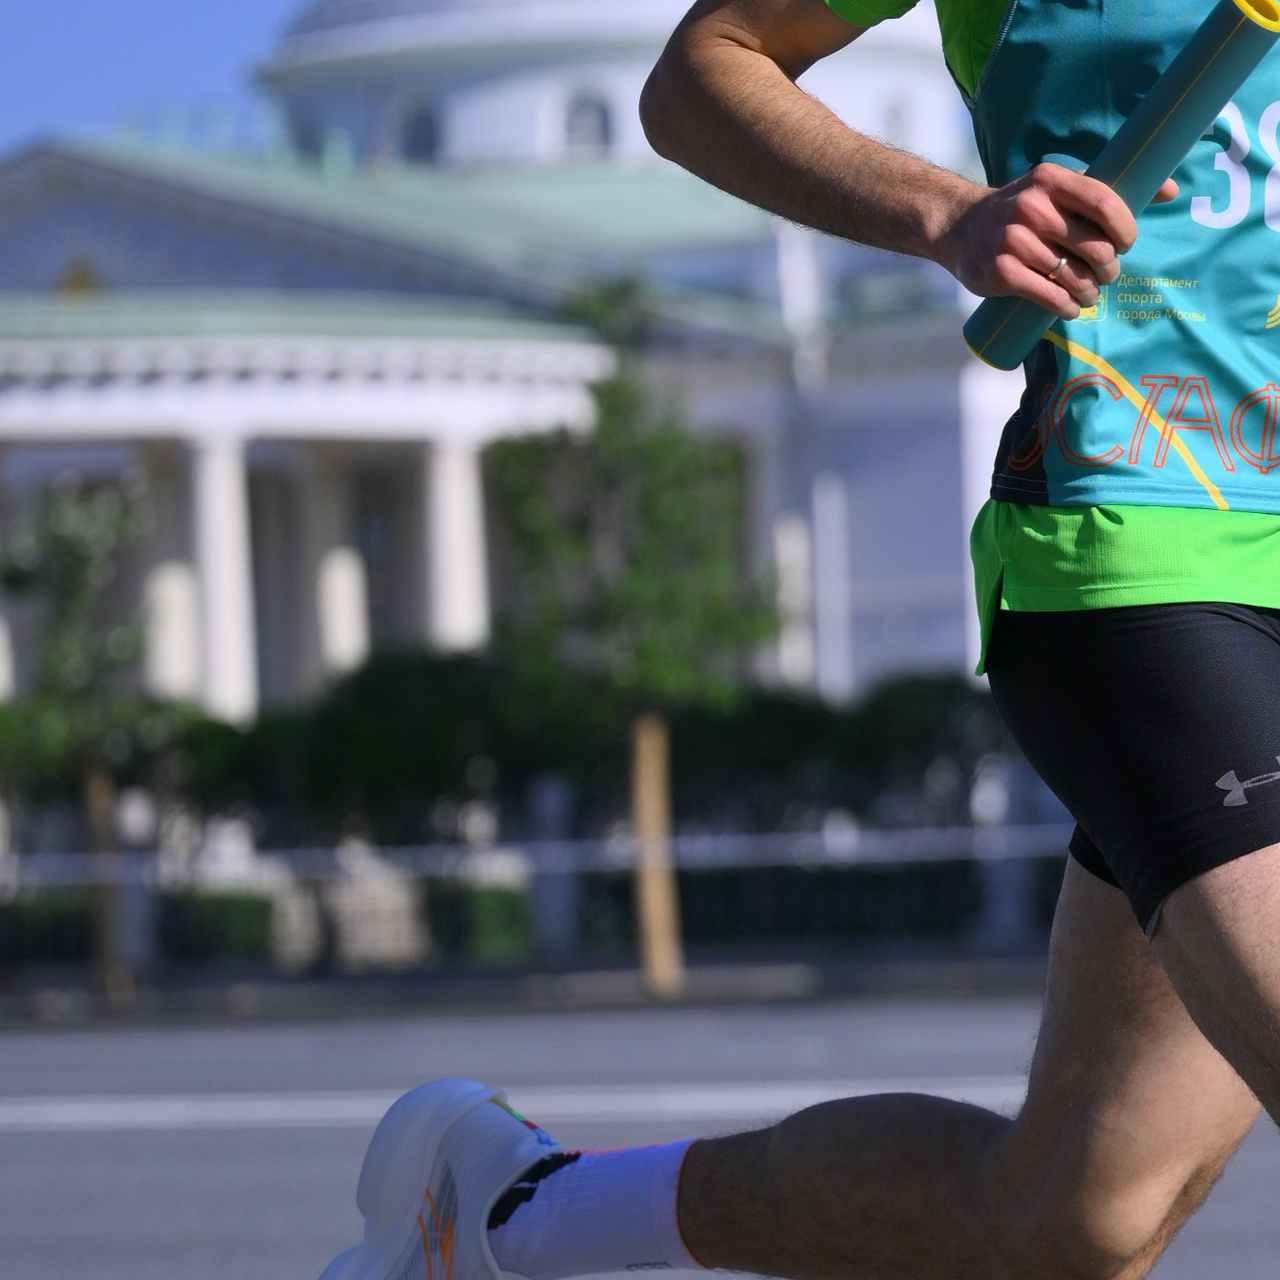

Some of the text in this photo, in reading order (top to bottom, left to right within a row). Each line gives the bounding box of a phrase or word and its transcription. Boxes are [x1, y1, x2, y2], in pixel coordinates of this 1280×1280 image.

[1117, 273, 1199, 290] Департамент
[1117, 293, 1163, 307] спорта
[1115, 308, 1206, 323] города Москвы
